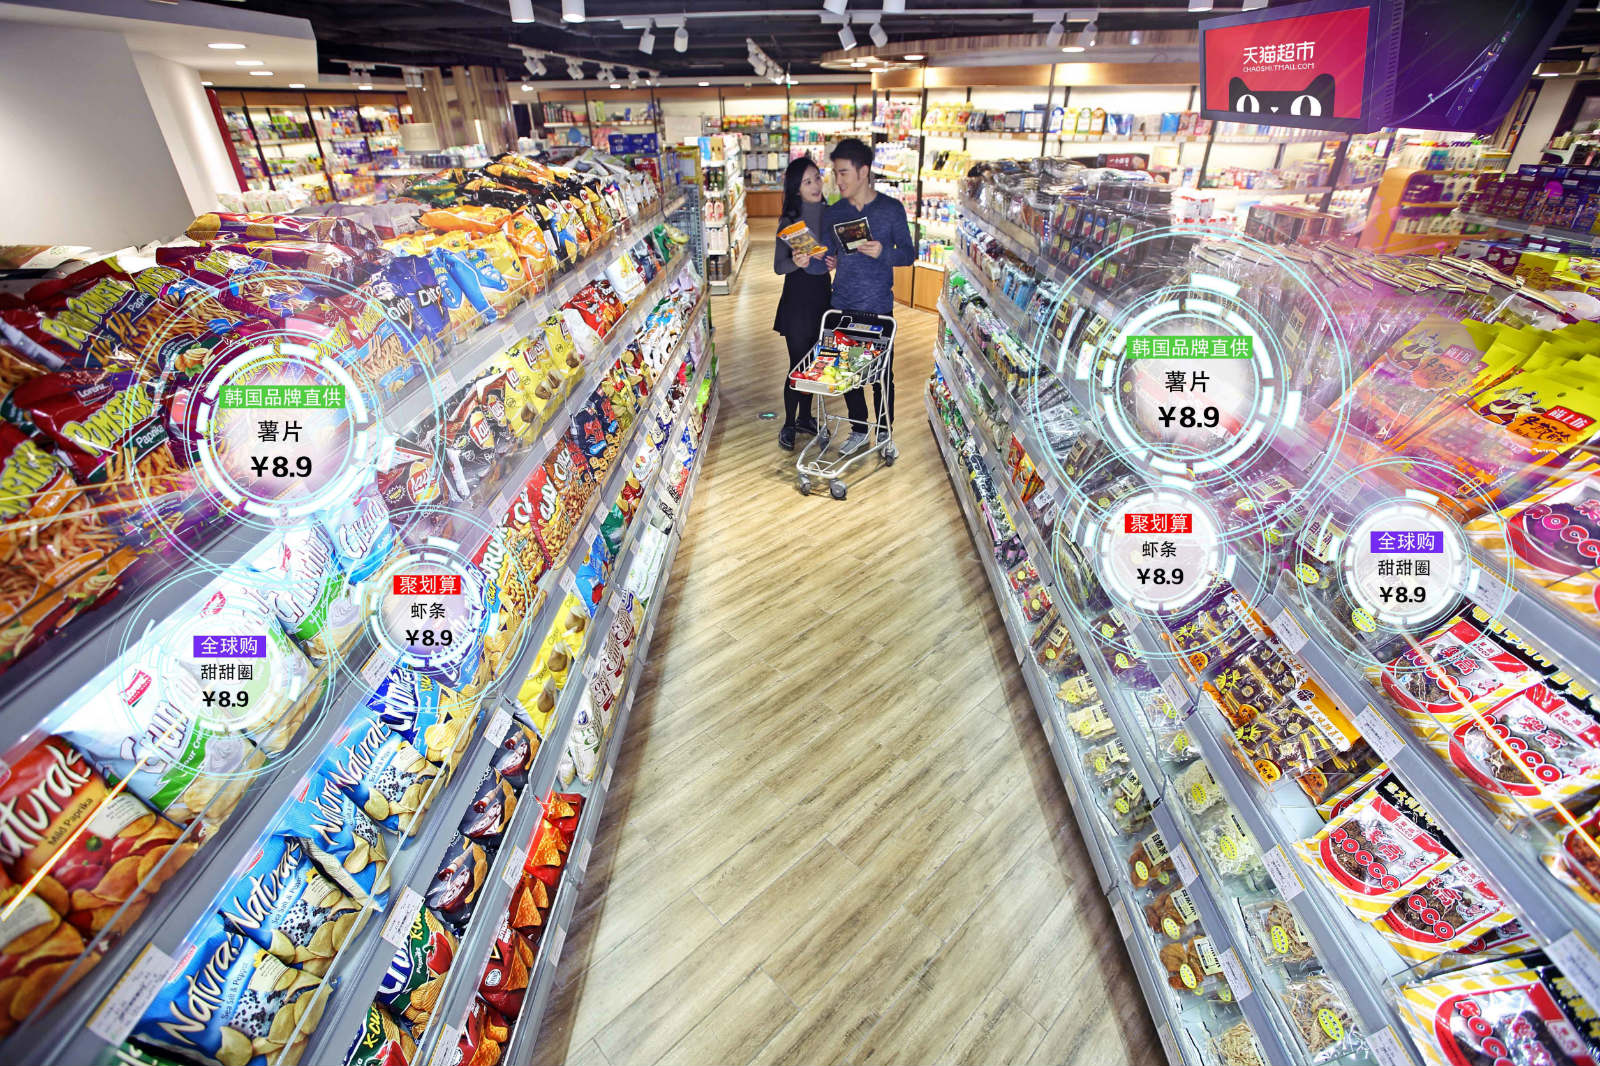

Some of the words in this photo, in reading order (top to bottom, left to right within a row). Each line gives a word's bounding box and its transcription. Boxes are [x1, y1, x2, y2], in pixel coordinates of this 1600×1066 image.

[1243, 41, 1315, 65] 天猫超市
[1472, 714, 1563, 783] ROCCO
[63, 796, 94, 829] Paprika
[1329, 827, 1401, 891] ROCCO
[157, 929, 245, 1047] Naturals
